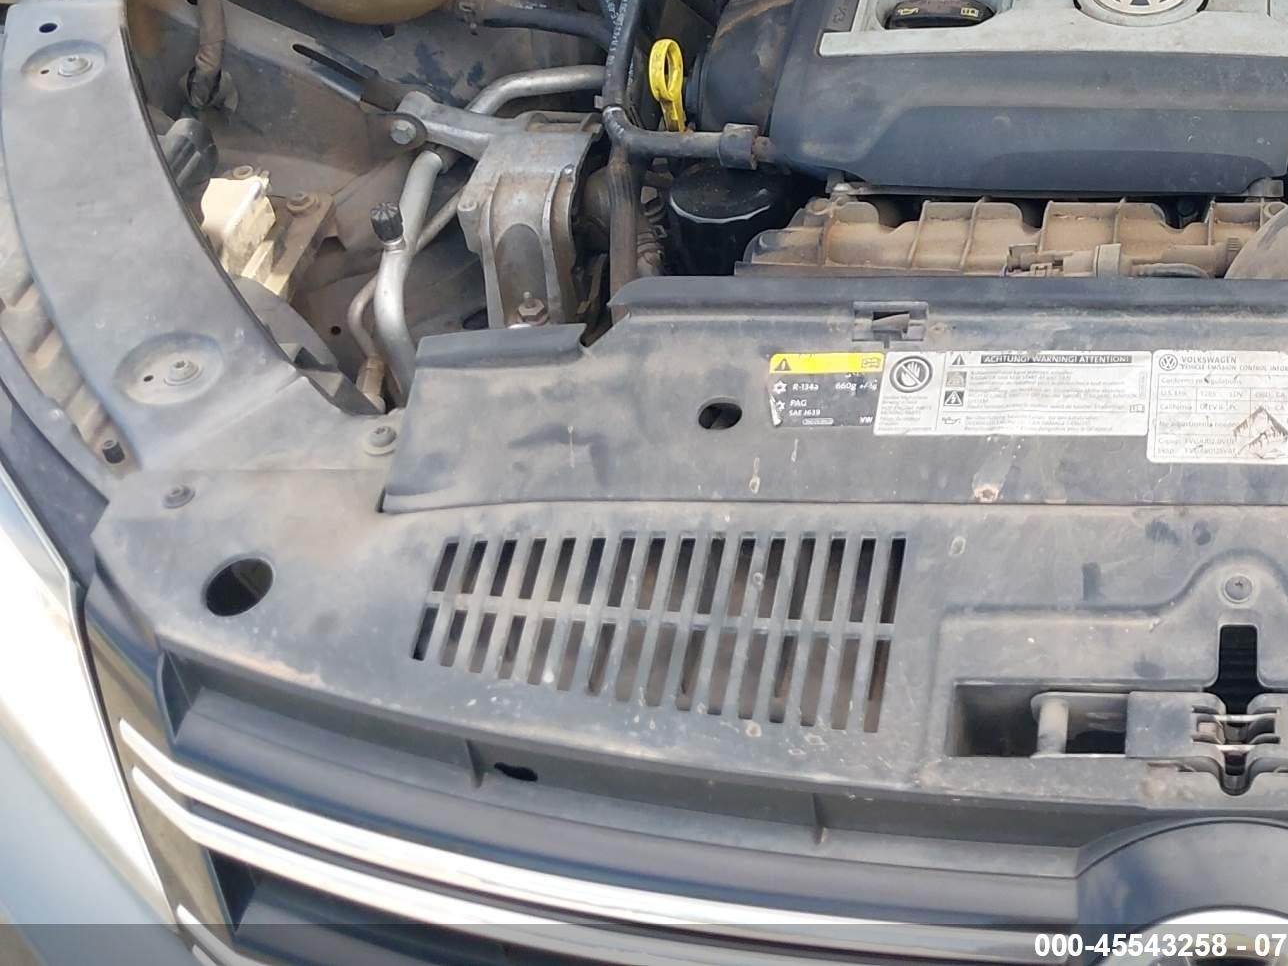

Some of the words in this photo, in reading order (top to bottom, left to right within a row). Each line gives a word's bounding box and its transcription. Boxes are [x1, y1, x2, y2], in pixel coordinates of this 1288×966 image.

[984, 354, 1029, 363] ACHTUNG!
[1079, 354, 1129, 363] ATTENTION!
[1181, 356, 1237, 364] VOLKSWAGEN
[792, 383, 819, 391] R-134a
[835, 382, 857, 392] 660g
[789, 399, 808, 408] PAG
[788, 409, 803, 417] SAE
[860, 416, 874, 424] VW
